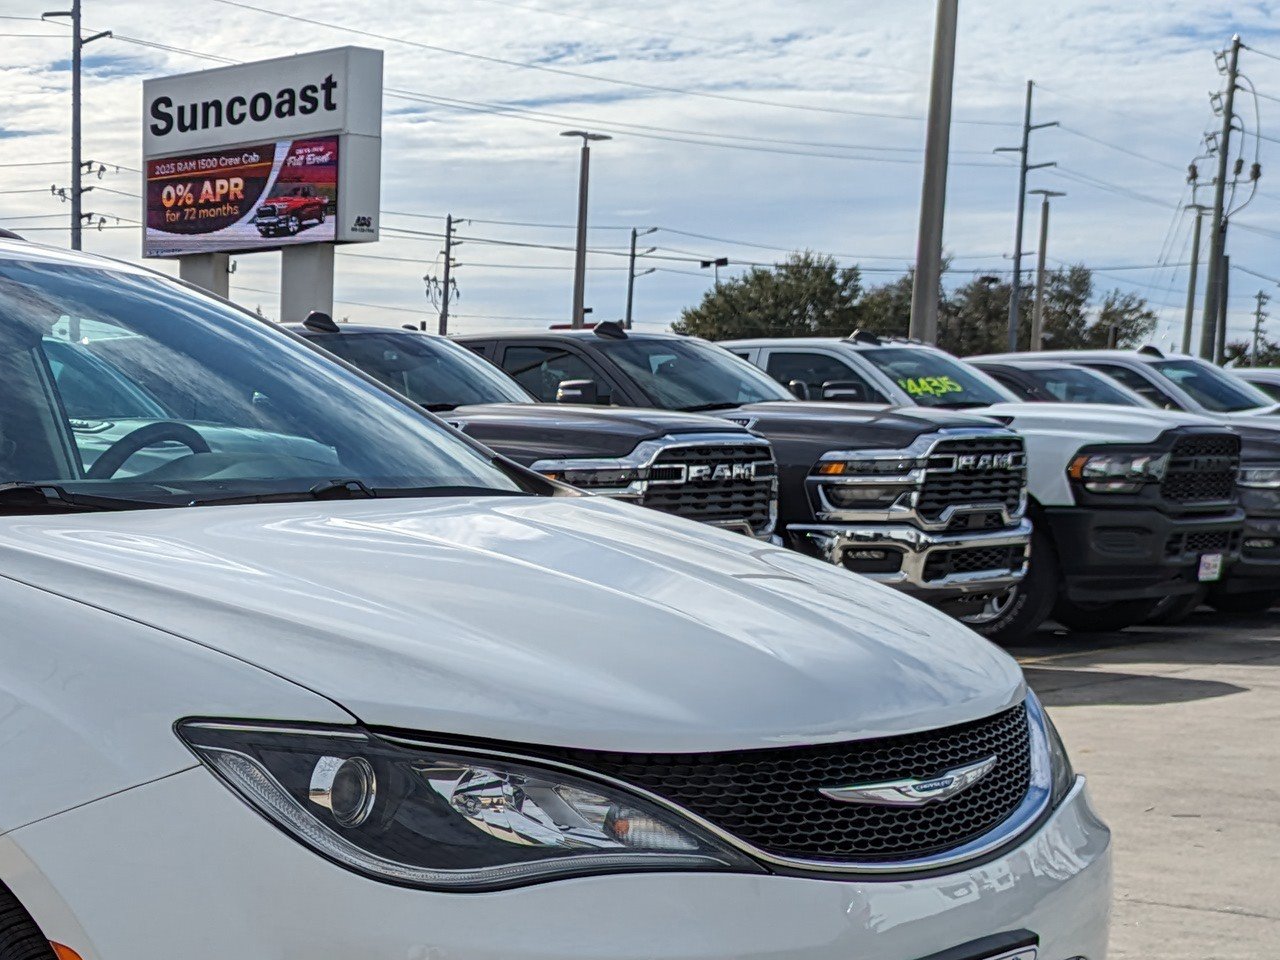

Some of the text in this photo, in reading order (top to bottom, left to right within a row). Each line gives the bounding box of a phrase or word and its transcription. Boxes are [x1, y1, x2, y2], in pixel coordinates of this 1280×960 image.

[150, 74, 337, 136] Suncoast
[154, 163, 175, 175] 2025
[177, 160, 196, 172] RAM
[198, 158, 218, 169] 1500
[242, 152, 260, 164] Cab
[162, 177, 245, 208] 0% APR
[165, 203, 239, 222] for 72 months
[688, 463, 751, 481] RAM
[958, 454, 1010, 470] RAM
